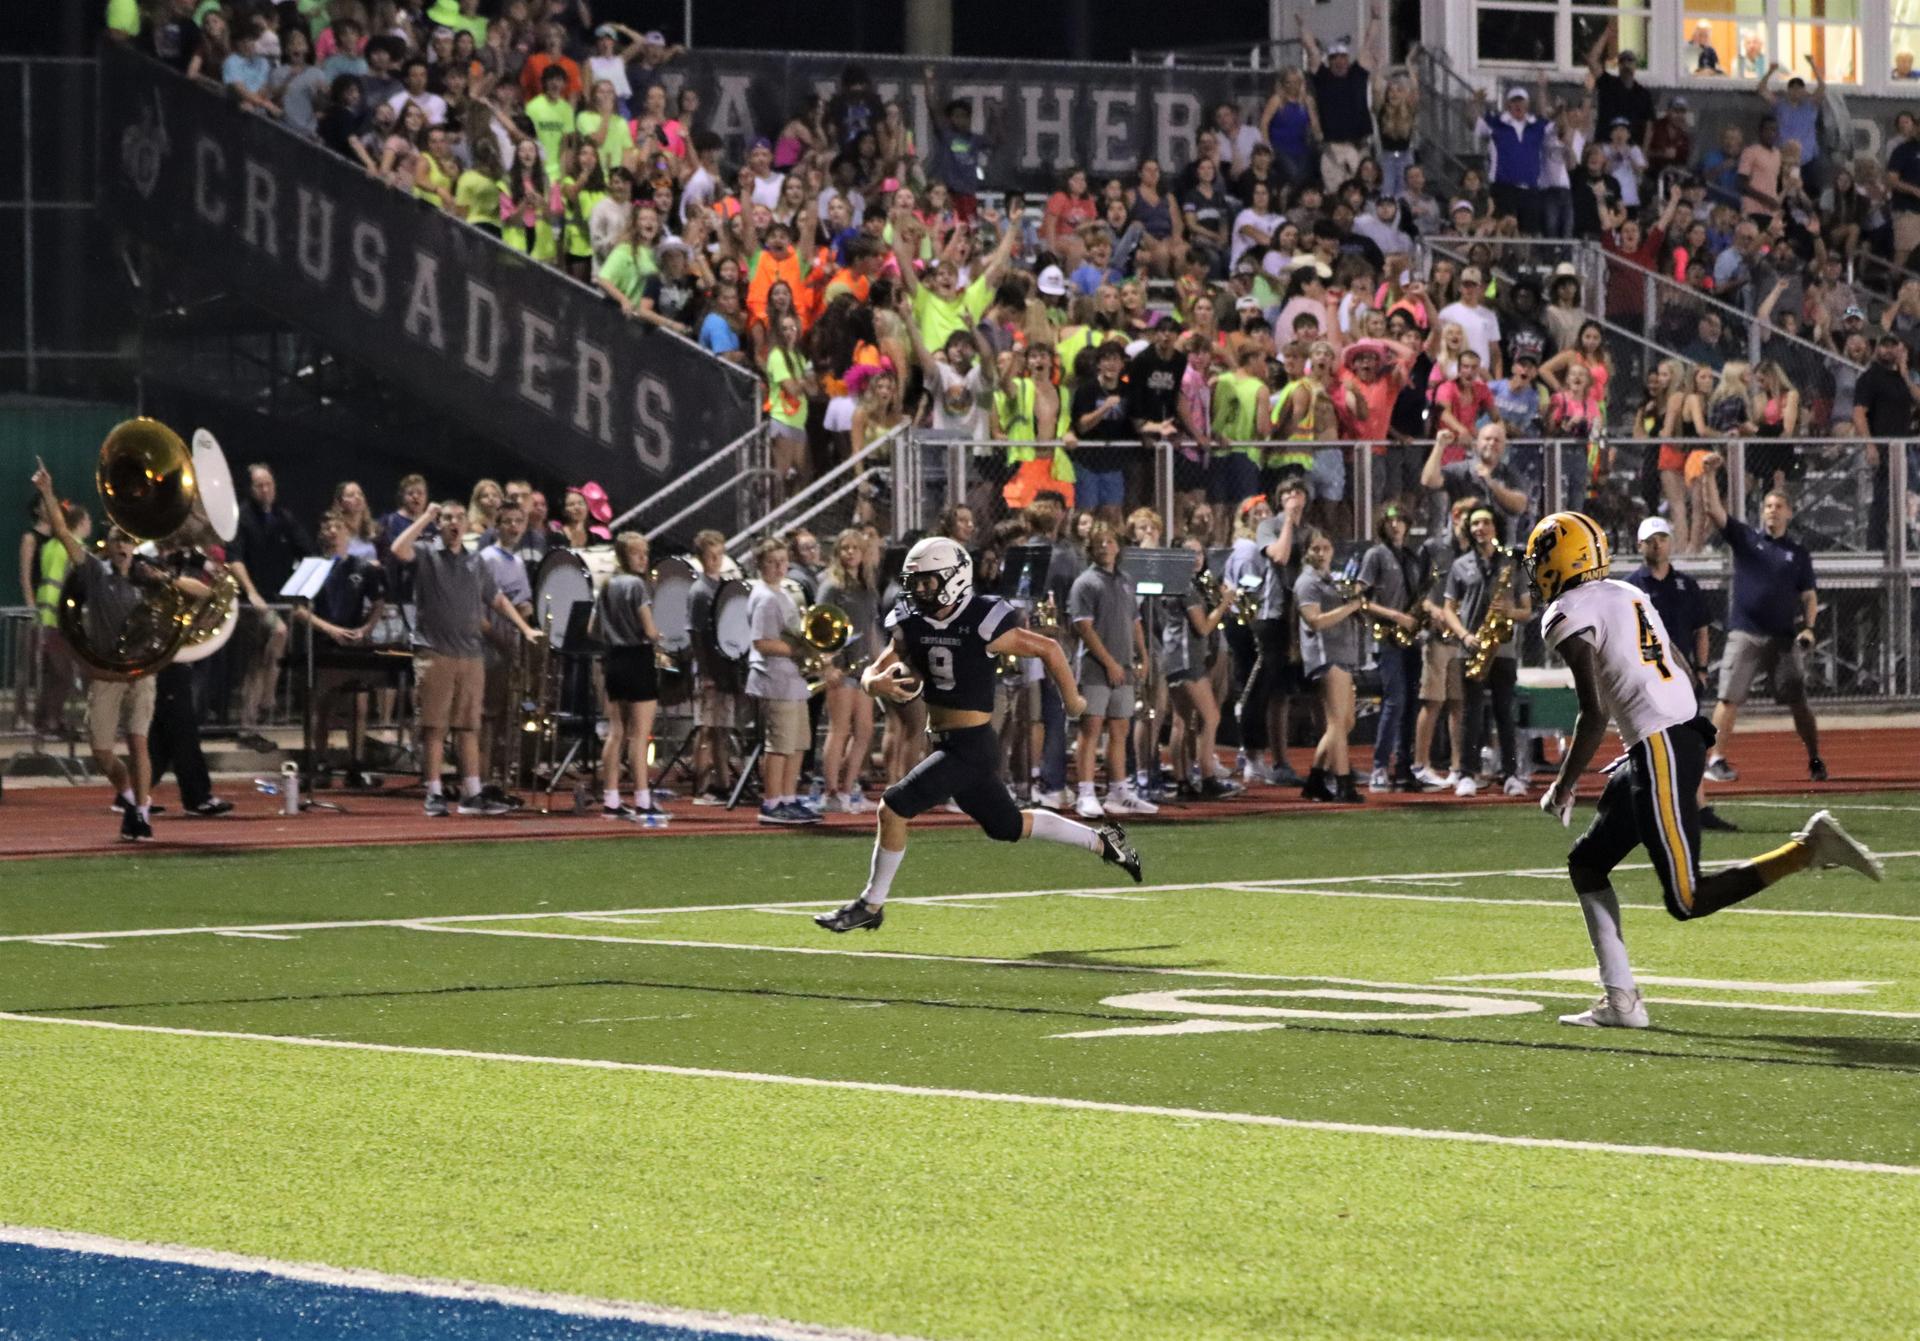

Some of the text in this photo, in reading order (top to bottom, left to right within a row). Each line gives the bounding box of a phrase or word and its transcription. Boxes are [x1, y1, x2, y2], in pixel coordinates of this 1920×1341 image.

[193, 137, 674, 474] CRUSADERS
[928, 646, 956, 690] 9
[1632, 600, 1673, 682] 4
